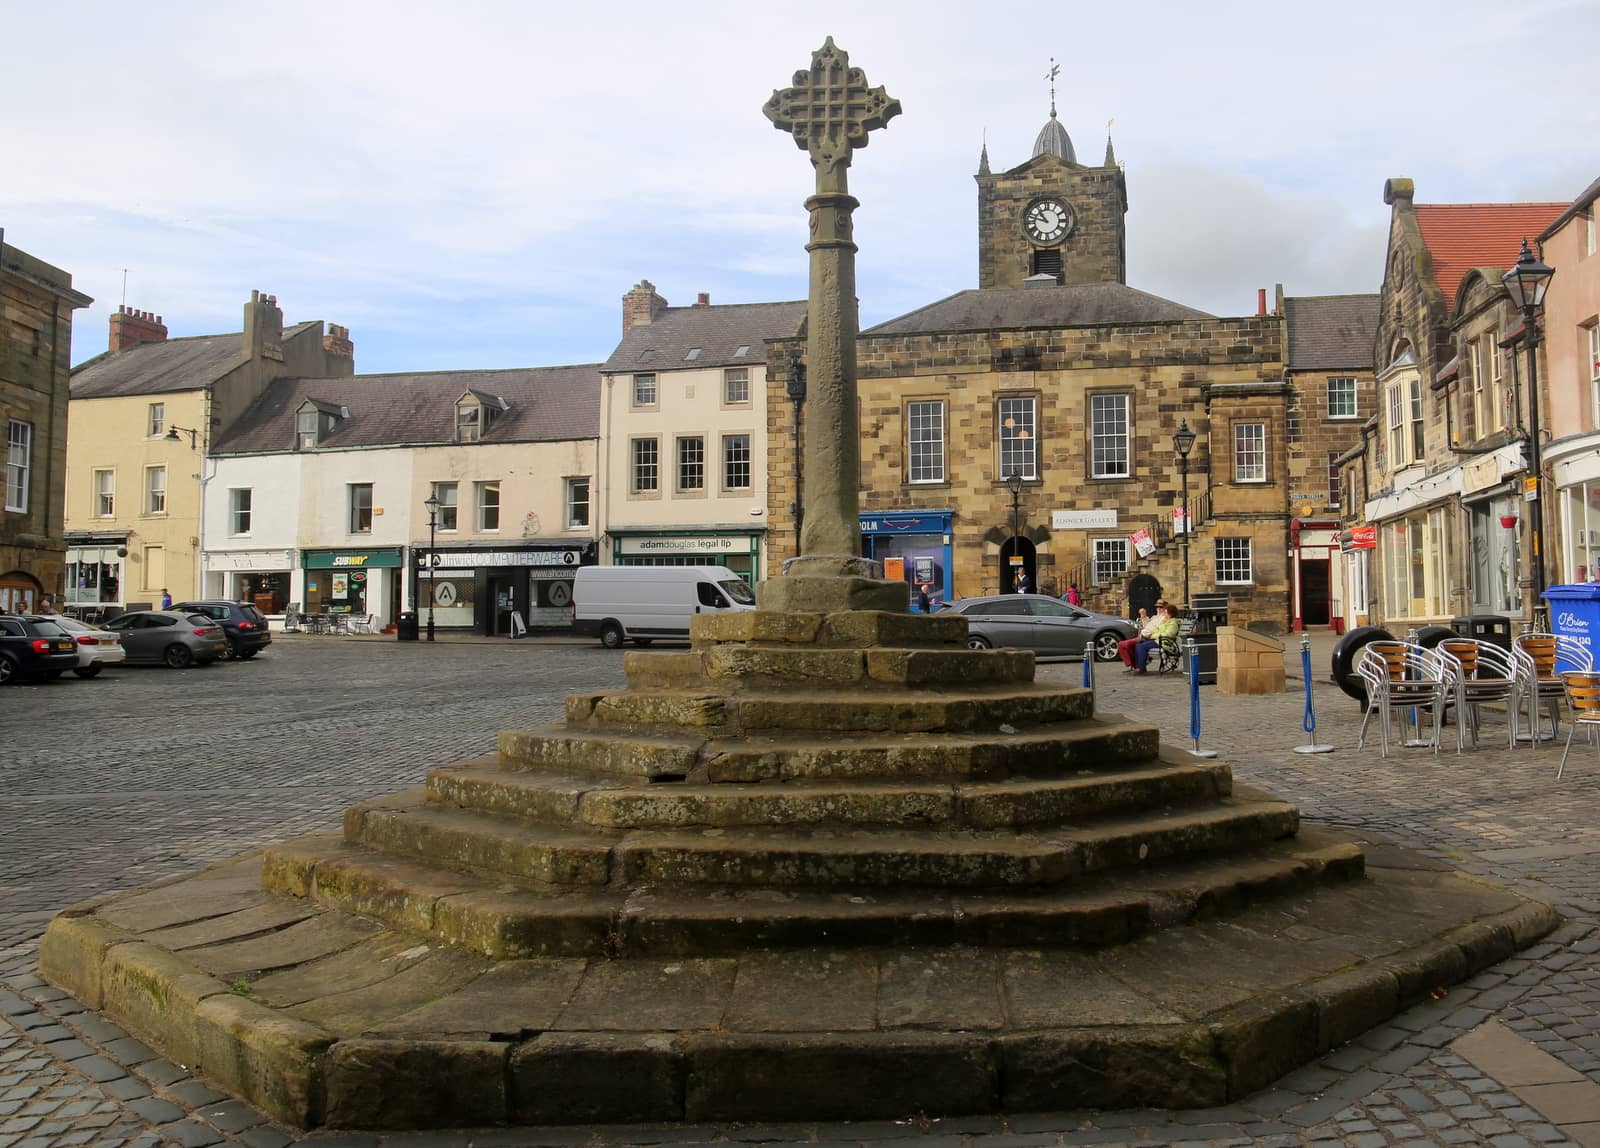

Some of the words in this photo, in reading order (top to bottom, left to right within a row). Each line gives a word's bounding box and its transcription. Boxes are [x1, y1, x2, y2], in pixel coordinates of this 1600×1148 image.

[640, 540, 696, 549] adamdouglas
[698, 538, 718, 549] legal
[721, 538, 731, 548] llp
[332, 555, 368, 566] SUBWAY
[1558, 612, 1589, 627] O'Brien
